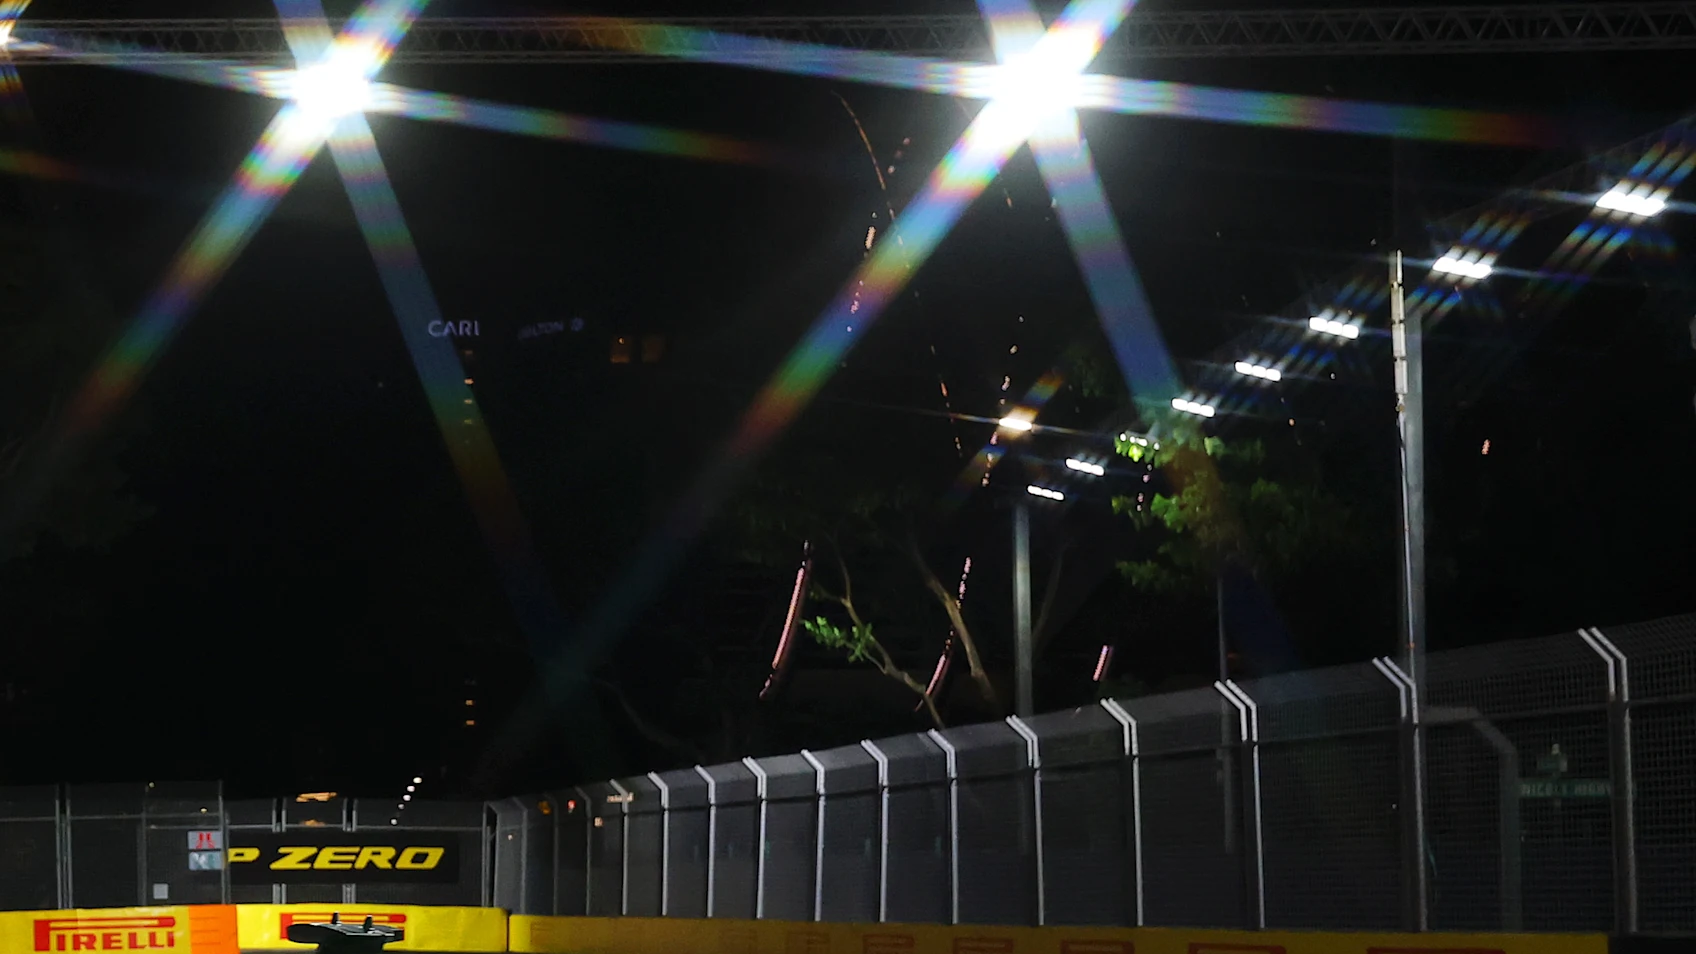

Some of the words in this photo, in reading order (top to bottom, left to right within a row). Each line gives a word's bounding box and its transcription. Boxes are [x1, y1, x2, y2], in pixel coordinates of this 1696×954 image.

[225, 847, 261, 868] P
[269, 846, 445, 870] ZERO
[33, 916, 176, 953] PIRELLI
